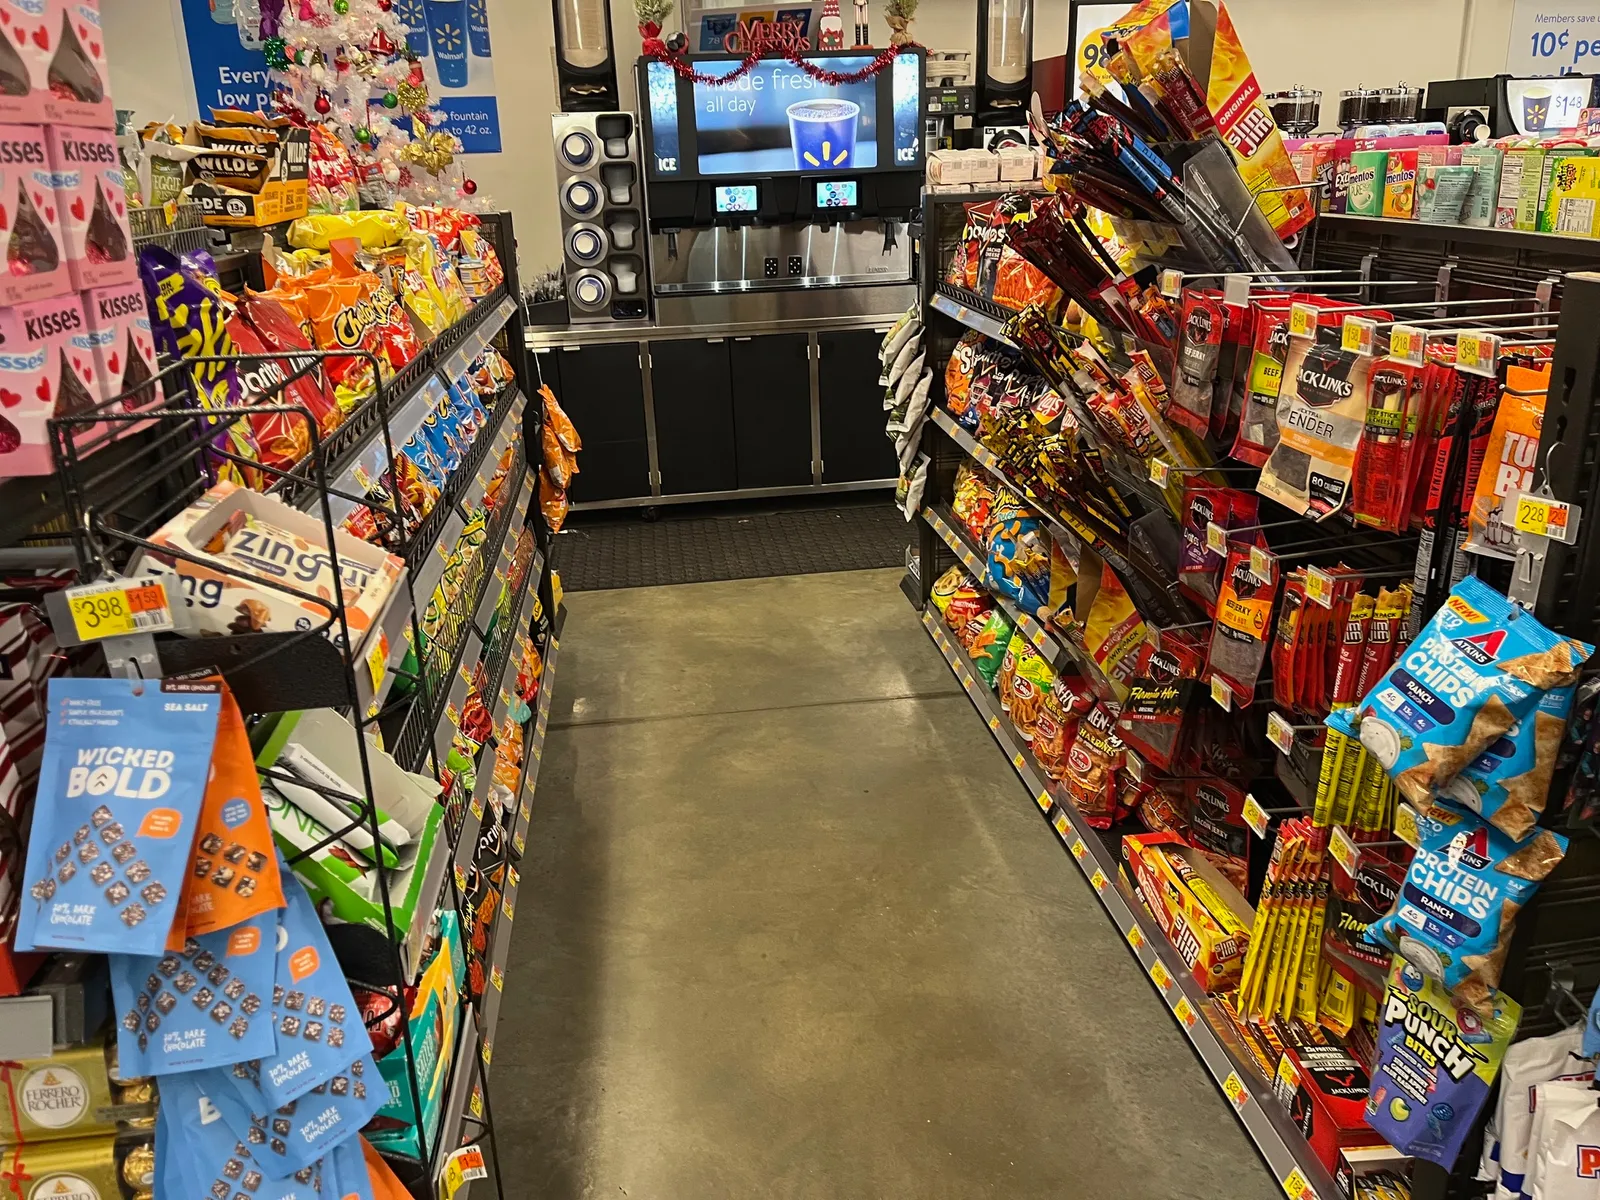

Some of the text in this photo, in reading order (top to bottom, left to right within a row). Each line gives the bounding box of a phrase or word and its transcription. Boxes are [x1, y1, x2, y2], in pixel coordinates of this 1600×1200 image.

[1535, 14, 1595, 23] Members save
[738, 20, 804, 41] MERRY
[1531, 29, 1569, 57] 10¢
[437, 51, 464, 60] Walmart
[217, 88, 251, 106] low
[706, 95, 757, 116] all day
[1219, 84, 1255, 126] ORIGINAL
[450, 110, 489, 121] fountain
[452, 125, 463, 136] to
[465, 124, 477, 135] 42
[287, 141, 308, 164] WILDE
[897, 148, 915, 161] ICE
[195, 156, 259, 172] WILDE
[658, 157, 677, 171] ICE
[1350, 170, 1375, 183] mentos
[1386, 169, 1415, 184] mentos
[1268, 330, 1289, 346] JACK
[1263, 366, 1279, 378] BEEF
[1318, 373, 1353, 397] LINK'S
[1380, 409, 1399, 419] STICK
[1501, 431, 1539, 469] TU
[1311, 476, 1323, 488] 80
[232, 530, 322, 582] zing
[1231, 565, 1246, 581] JACK
[1449, 597, 1481, 623] NEW!
[1123, 630, 1139, 648] PACK
[1454, 639, 1488, 664] ATKINS
[1148, 653, 1163, 669] JACK
[1405, 651, 1476, 708] CHIPS
[1406, 680, 1435, 706] RANCH
[164, 703, 208, 712] SEA SALT
[77, 746, 175, 769] WICKED
[66, 765, 171, 799] BOLD
[269, 800, 327, 843] ONE
[1355, 869, 1379, 893] JACK
[1416, 847, 1498, 901] PROTEIN
[1411, 862, 1490, 920] CHIPS
[73, 904, 97, 914] DARK
[1420, 895, 1454, 920] RANCH
[50, 913, 93, 926] CHOCOLATE
[1173, 915, 1200, 957] slim
[1356, 941, 1381, 956] ORIGINAL
[1407, 993, 1457, 1043] SOUR
[184, 1028, 207, 1039] DARK
[1385, 995, 1475, 1080] PUNCH
[163, 1038, 206, 1054] CHOCOLATE
[1404, 1035, 1437, 1068] BITES
[288, 1050, 309, 1068] DARK
[272, 1060, 312, 1087] CHOCOLATE
[26, 1085, 80, 1101] FERRERO
[28, 1097, 81, 1112] ROCHER
[317, 1105, 338, 1123] DARK
[304, 1114, 342, 1143] CHOCOLATE
